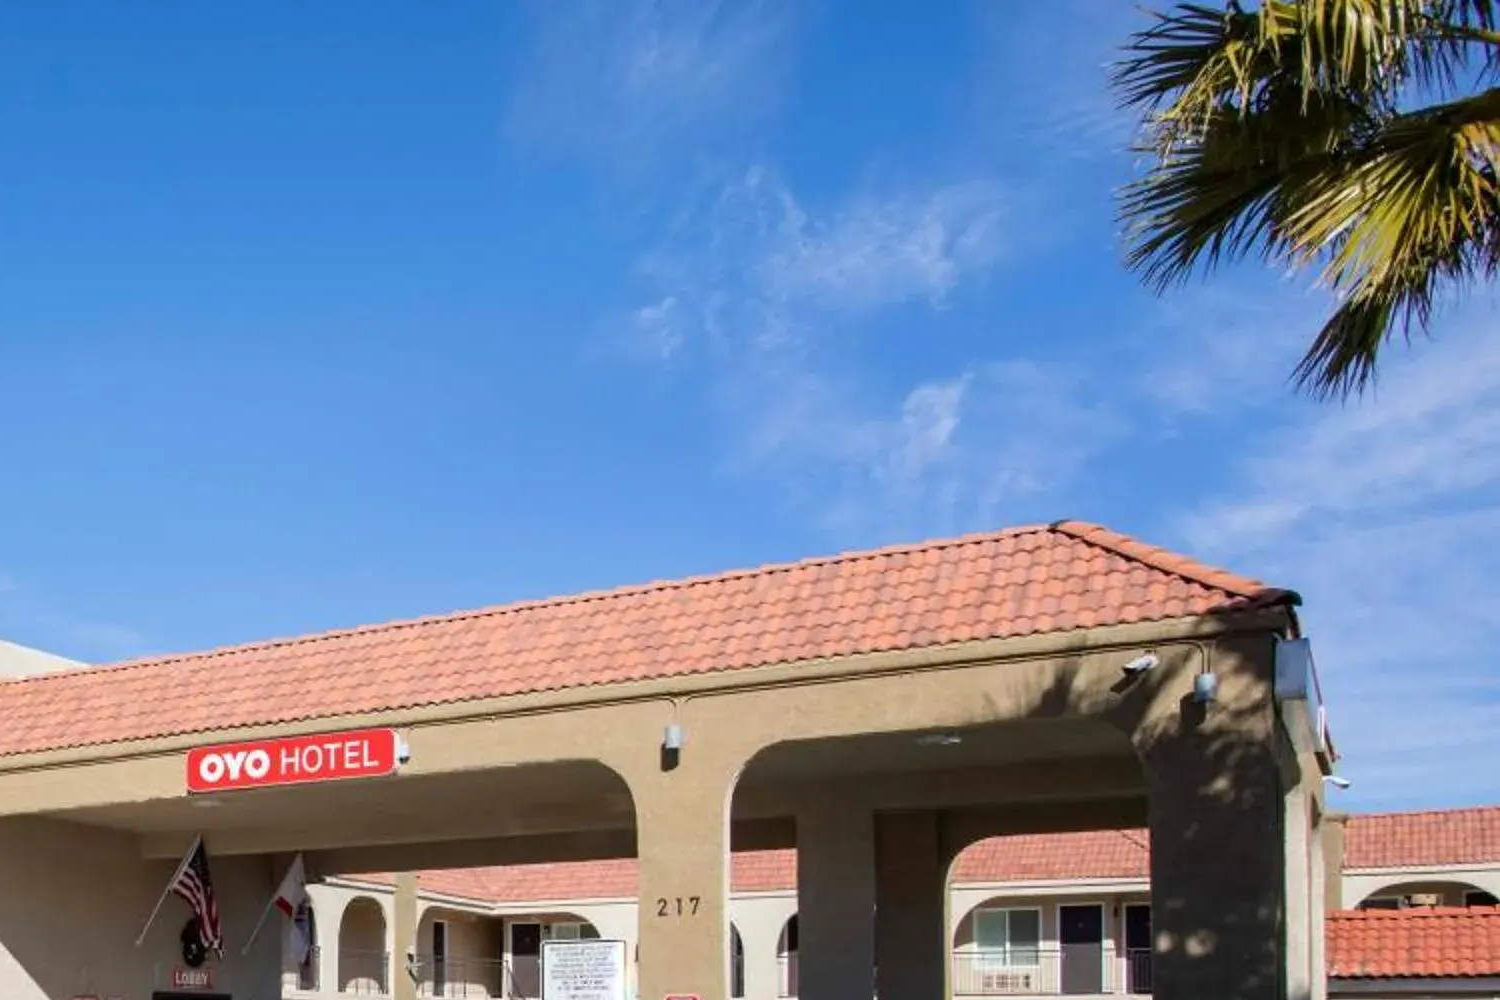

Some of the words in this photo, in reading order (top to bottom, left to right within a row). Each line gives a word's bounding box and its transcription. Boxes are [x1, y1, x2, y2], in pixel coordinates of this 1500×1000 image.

[199, 748, 271, 783] OYO
[279, 739, 380, 776] HOTEL
[656, 895, 701, 918] 217
